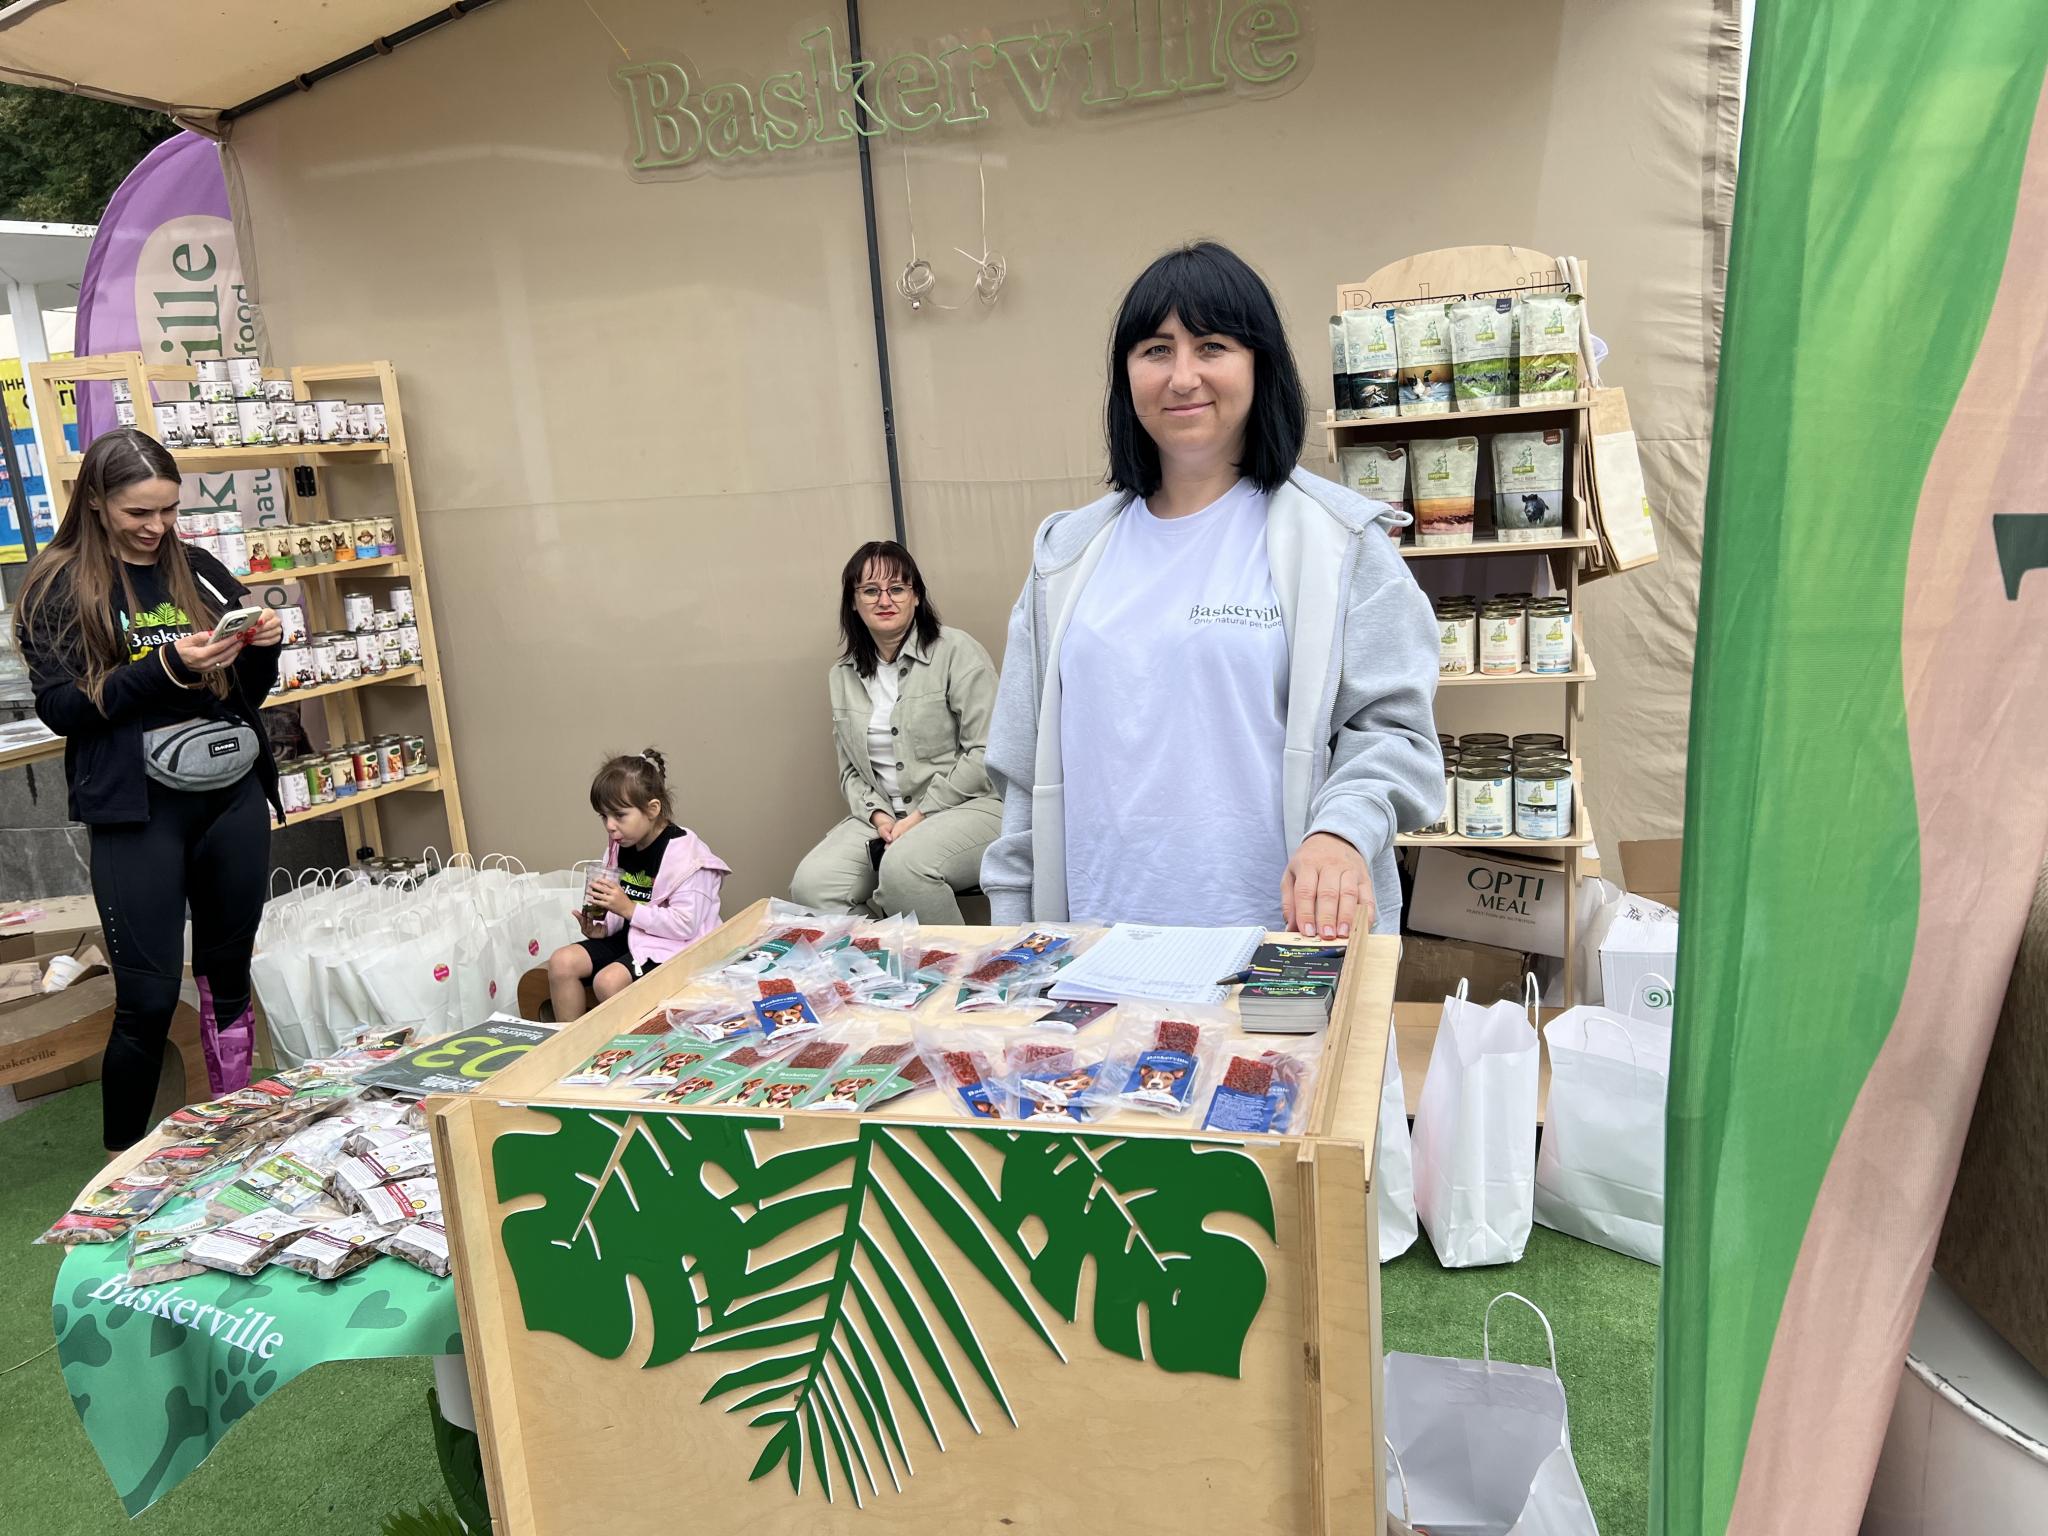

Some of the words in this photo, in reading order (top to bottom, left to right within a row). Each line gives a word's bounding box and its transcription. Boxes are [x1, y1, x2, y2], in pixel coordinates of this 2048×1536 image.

[617, 0, 1300, 169] Baskerville
[1189, 603, 1282, 621] Baskervill
[1215, 617, 1247, 625] natural
[1467, 867, 1544, 901] OPTI
[1477, 893, 1531, 916] MEAL
[0, 1049, 56, 1070] askerville
[87, 1273, 284, 1359] Baskerville
